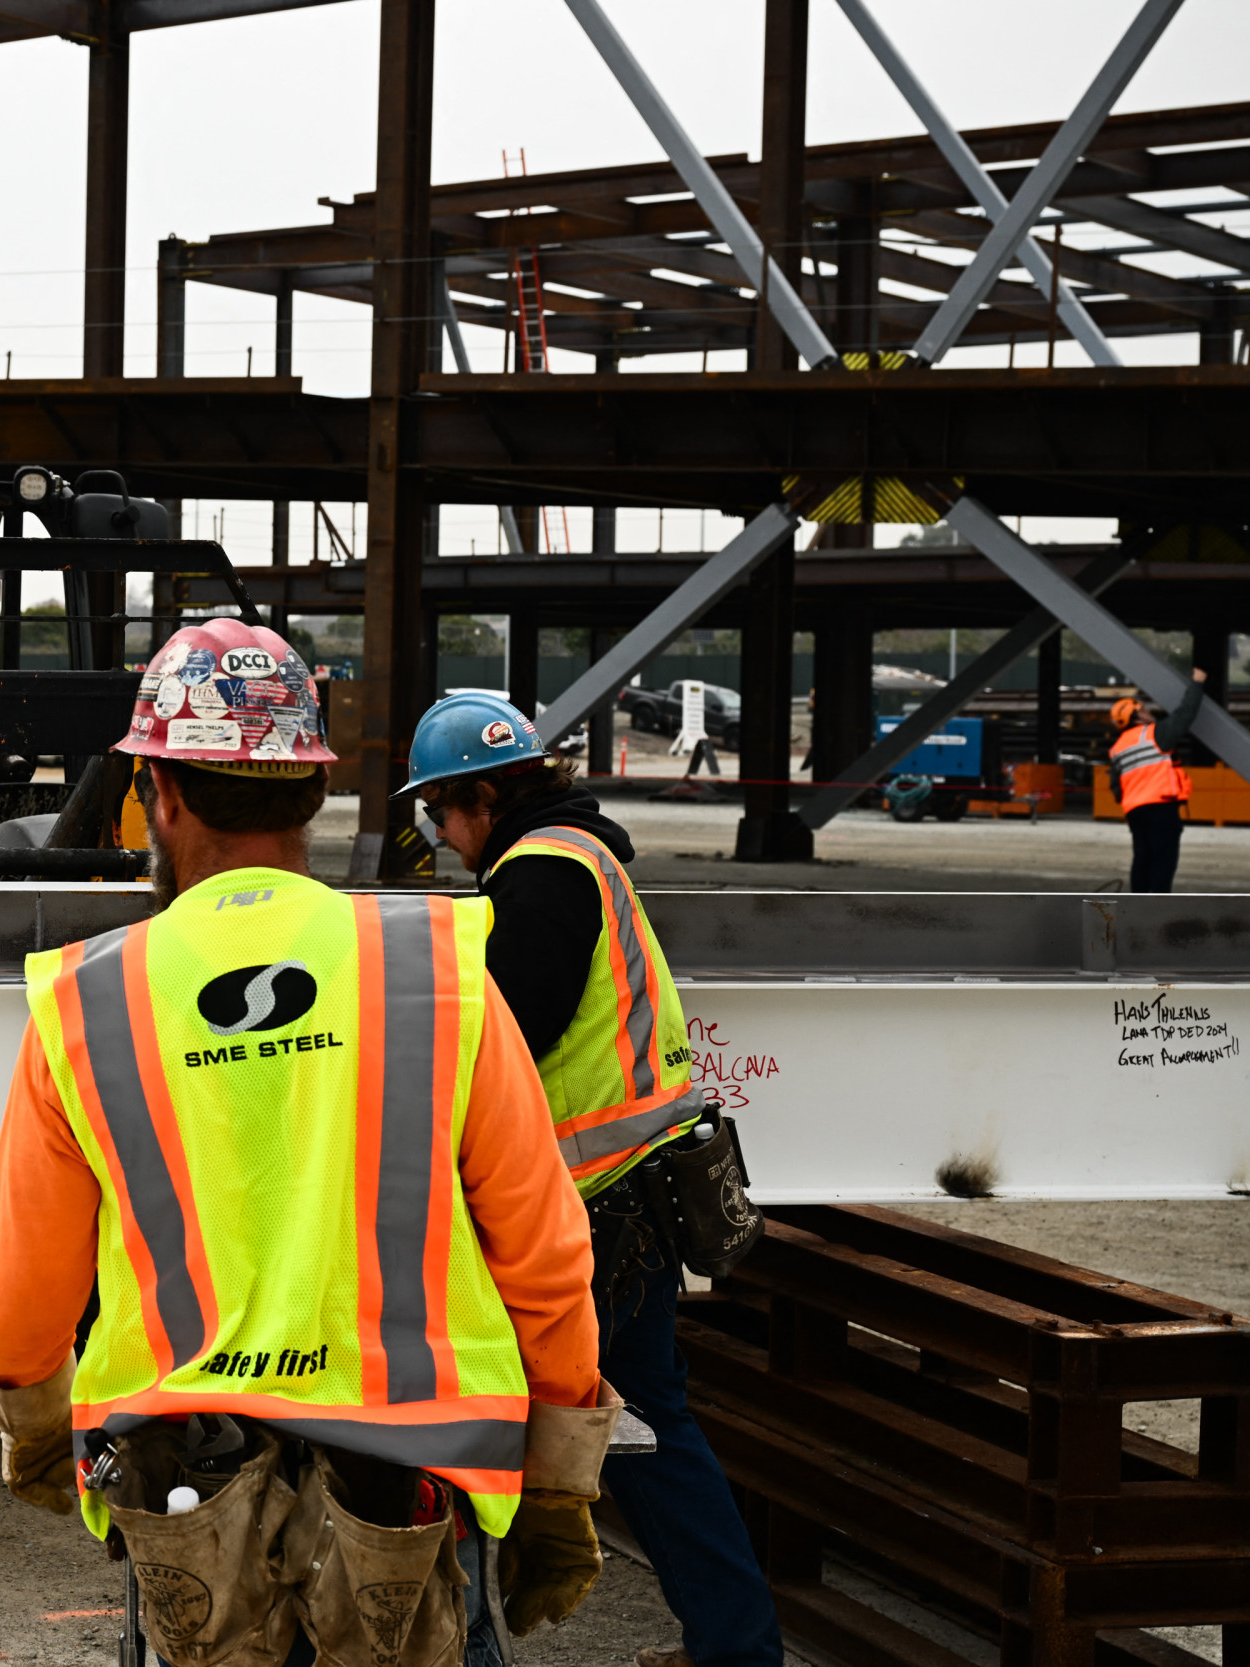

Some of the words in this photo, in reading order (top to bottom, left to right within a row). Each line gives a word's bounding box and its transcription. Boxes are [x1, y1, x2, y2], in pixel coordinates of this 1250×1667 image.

[228, 653, 271, 672] DCCI
[1114, 999, 1151, 1025] HANS
[1207, 1022, 1228, 1037] 2024
[185, 1045, 247, 1068] SME
[259, 1032, 343, 1058] STEEL
[1118, 1047, 1154, 1067] GREAT
[199, 1350, 271, 1378] afey
[276, 1344, 328, 1377] first
